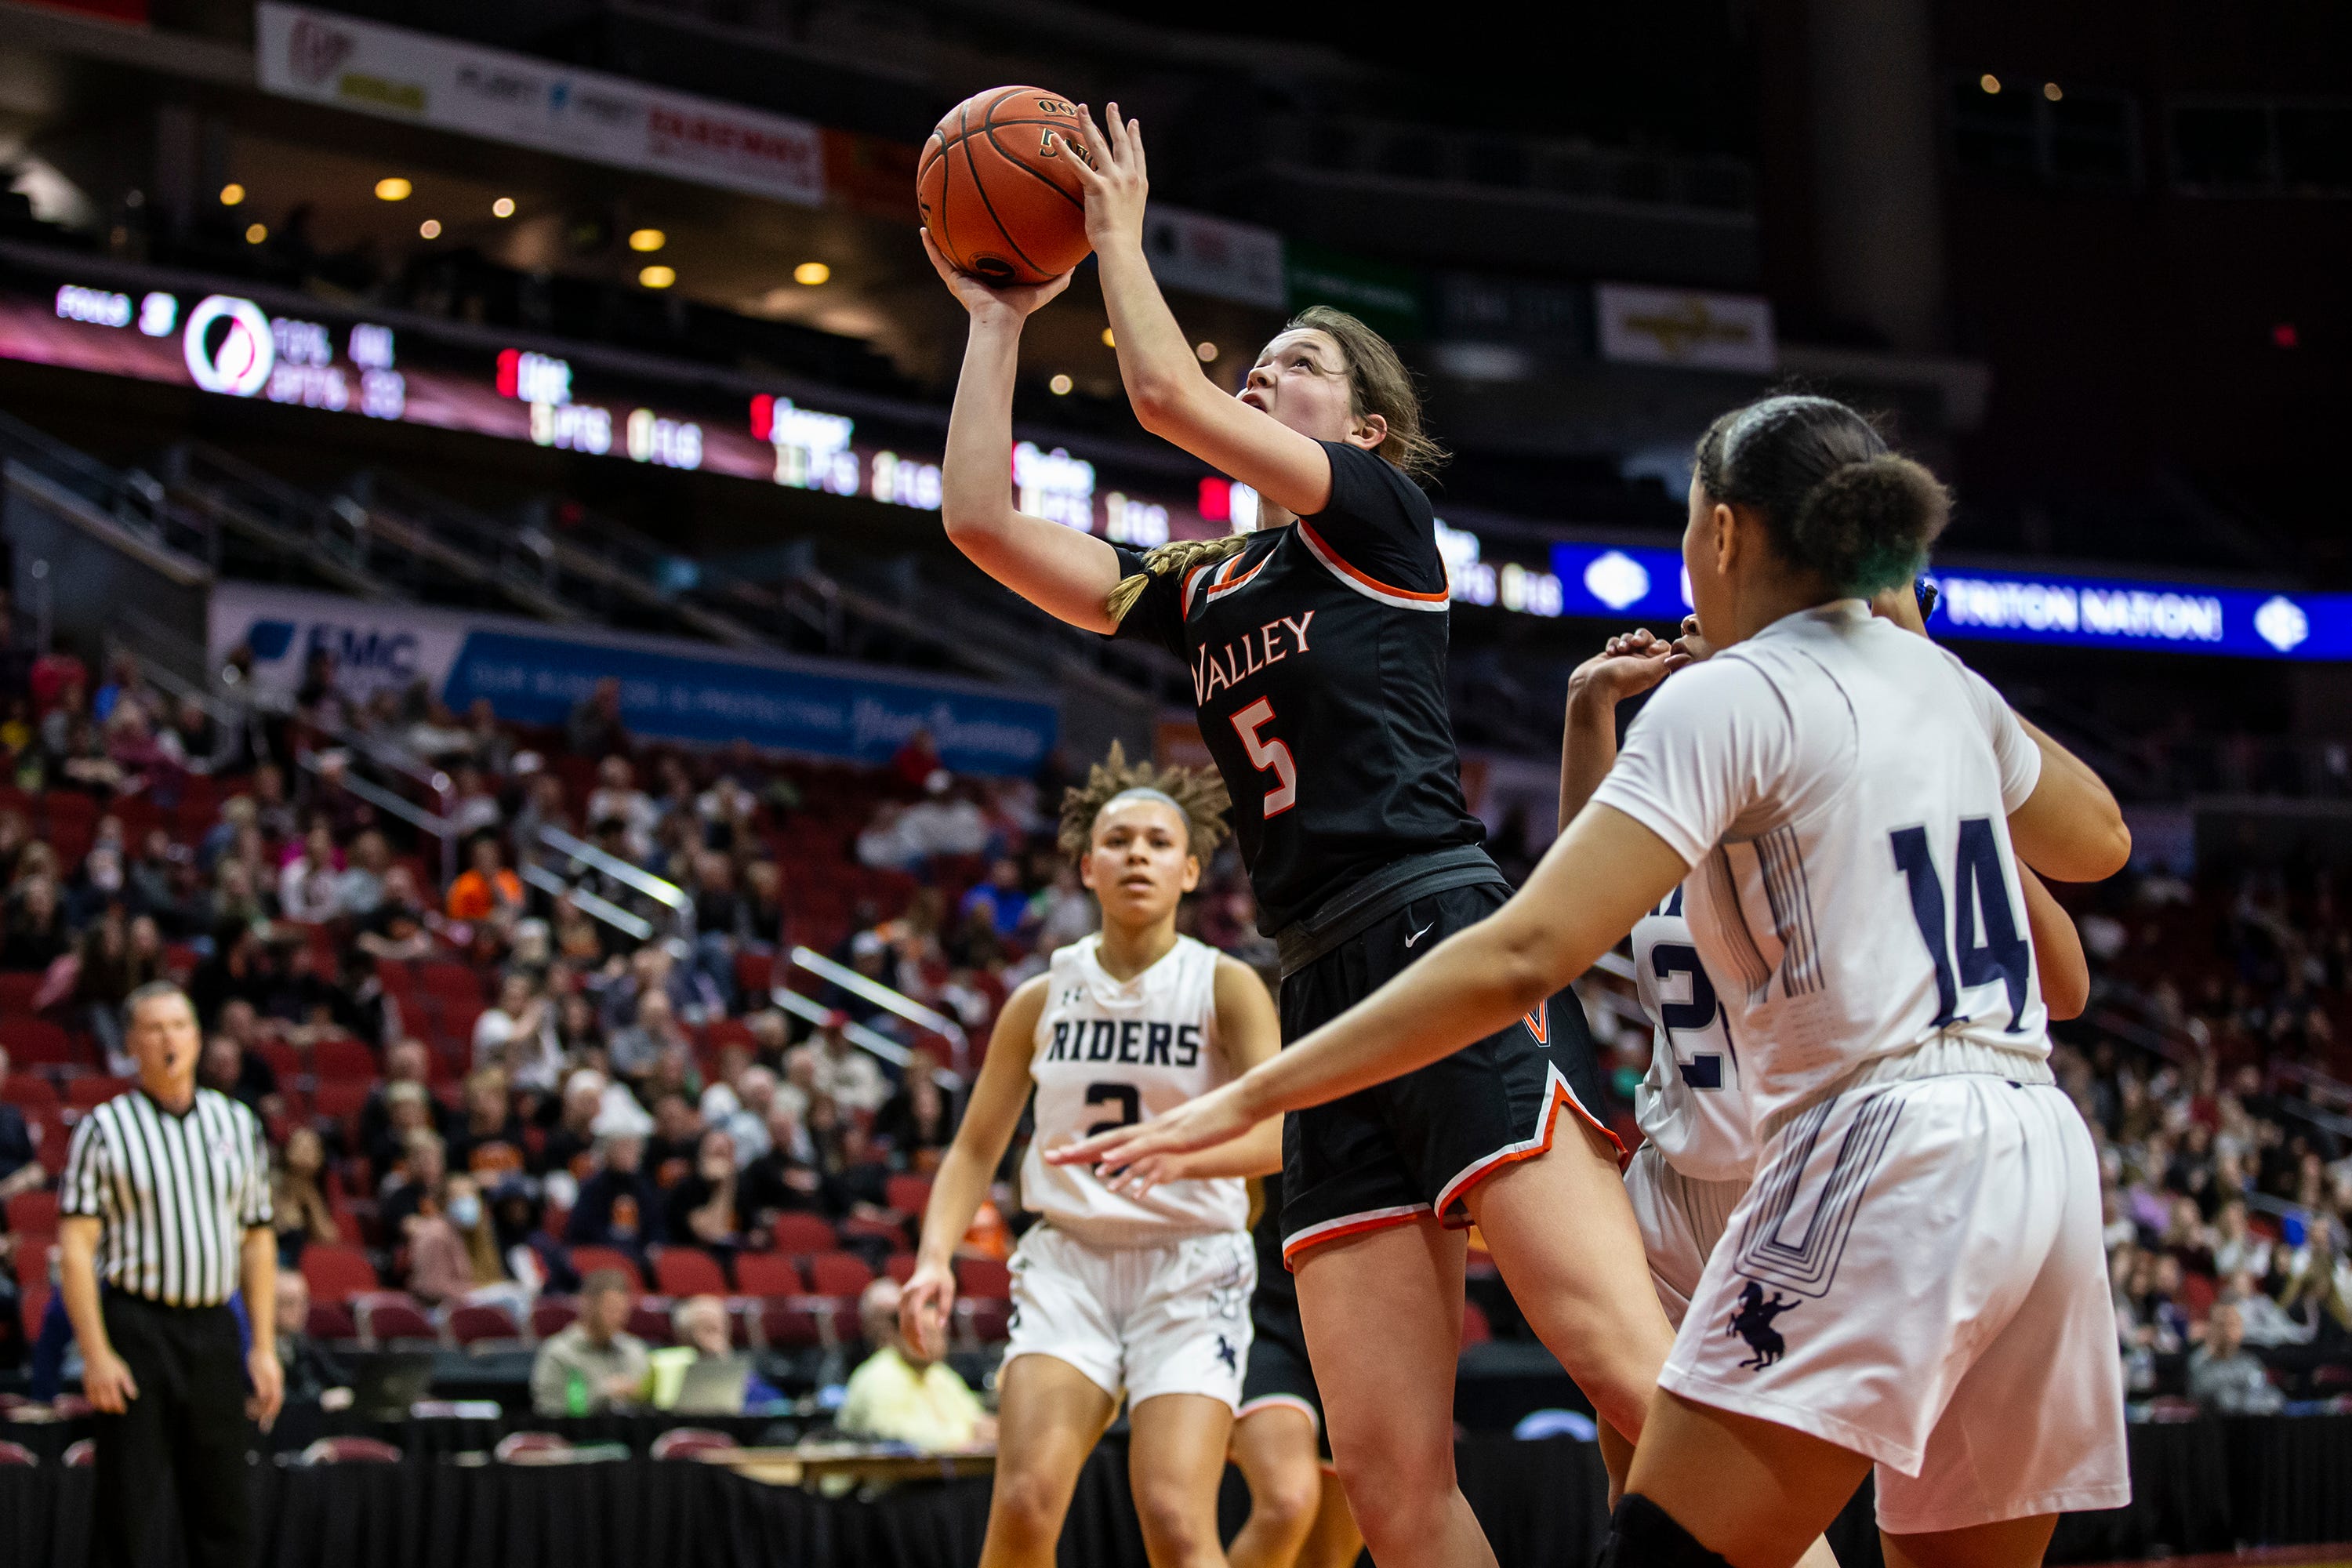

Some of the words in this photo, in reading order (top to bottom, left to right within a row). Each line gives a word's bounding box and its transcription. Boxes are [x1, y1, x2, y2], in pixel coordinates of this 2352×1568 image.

[1944, 577, 2079, 632] TRITON
[1191, 610, 1315, 707] VALLEY
[1229, 695, 1297, 820] 5
[1888, 818, 2032, 1034] 14
[1047, 1019, 1200, 1068] RIDERS
[1650, 942, 1739, 1091] 2
[1084, 1083, 1142, 1176] 2
